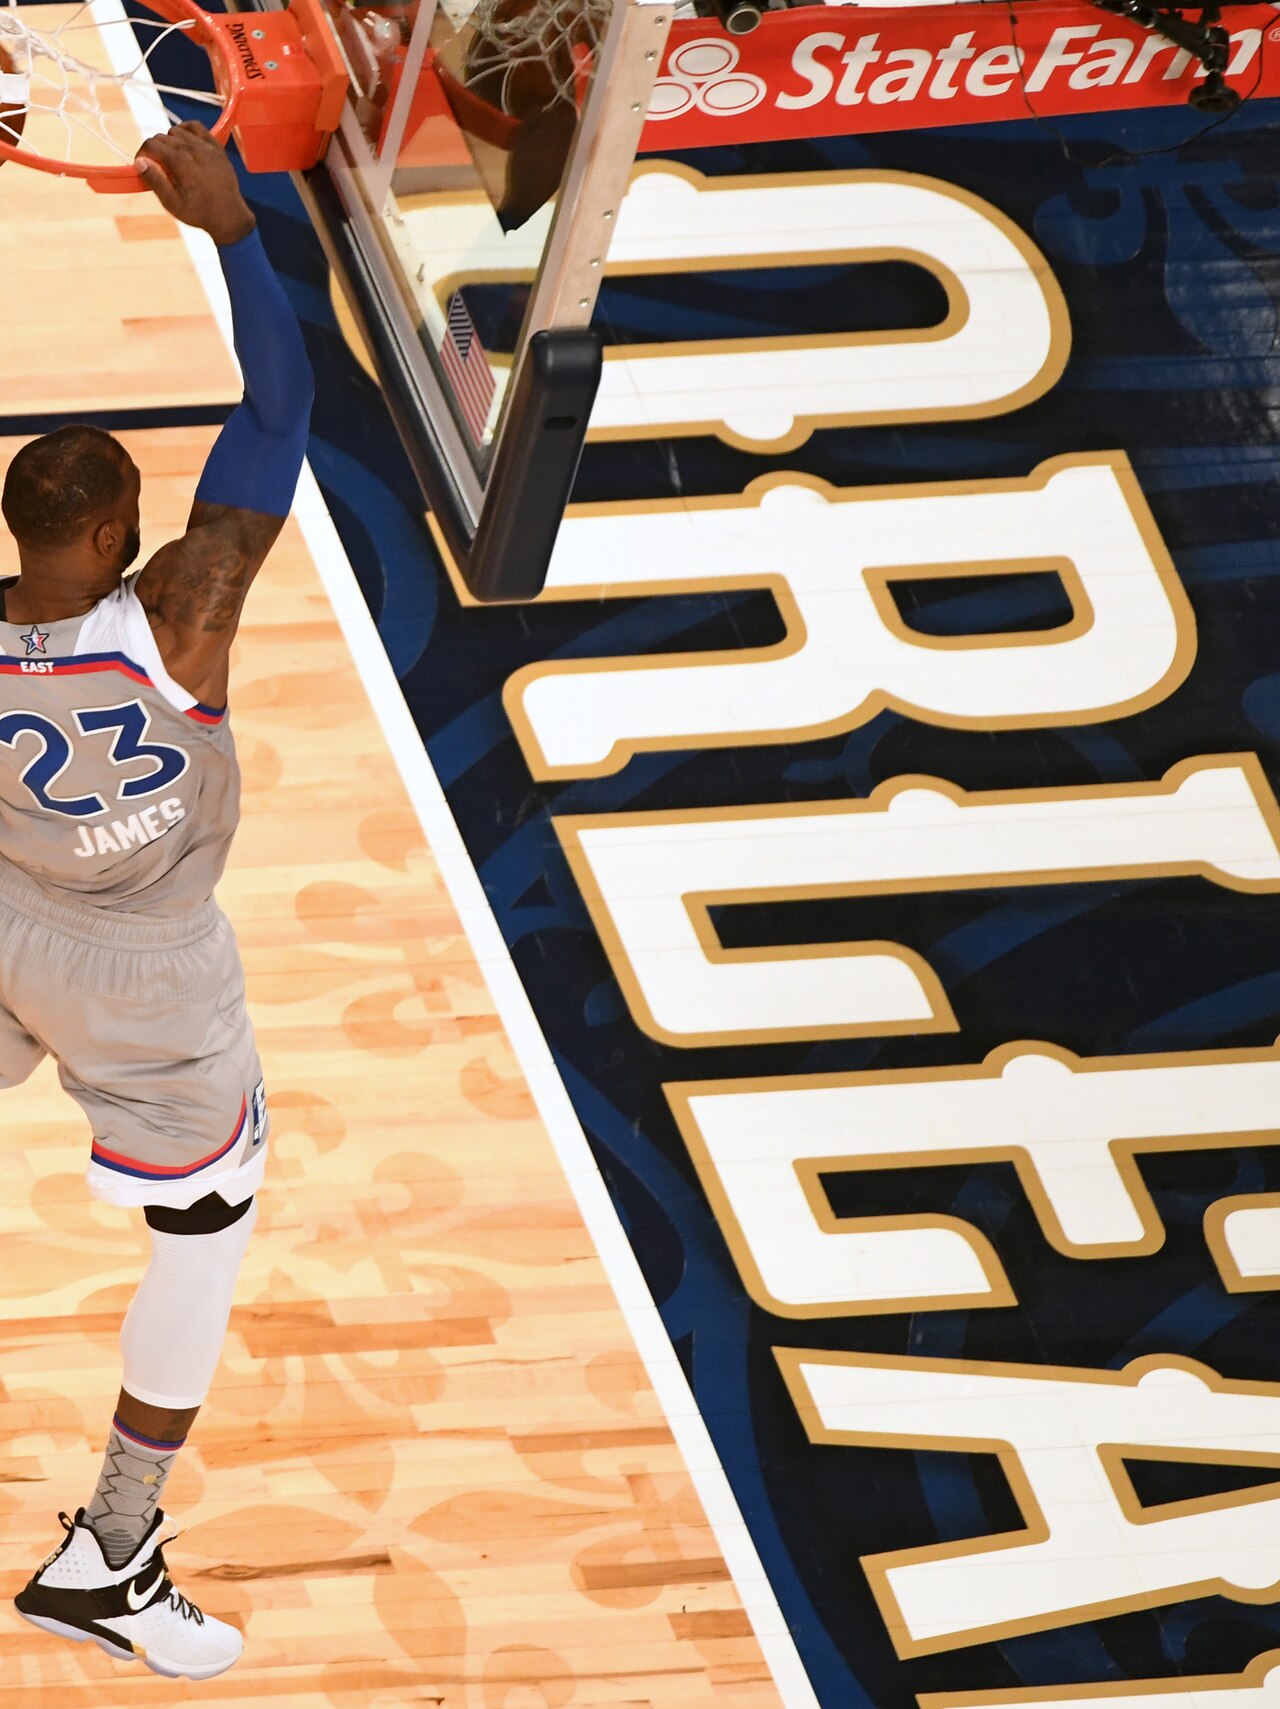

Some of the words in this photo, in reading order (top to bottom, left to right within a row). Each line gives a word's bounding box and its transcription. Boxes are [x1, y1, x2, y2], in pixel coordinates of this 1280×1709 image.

[225, 23, 265, 79] SPALDING
[20, 661, 54, 673] EAST
[74, 798, 186, 857] JAMES
[330, 160, 1280, 1709] ORLEA
